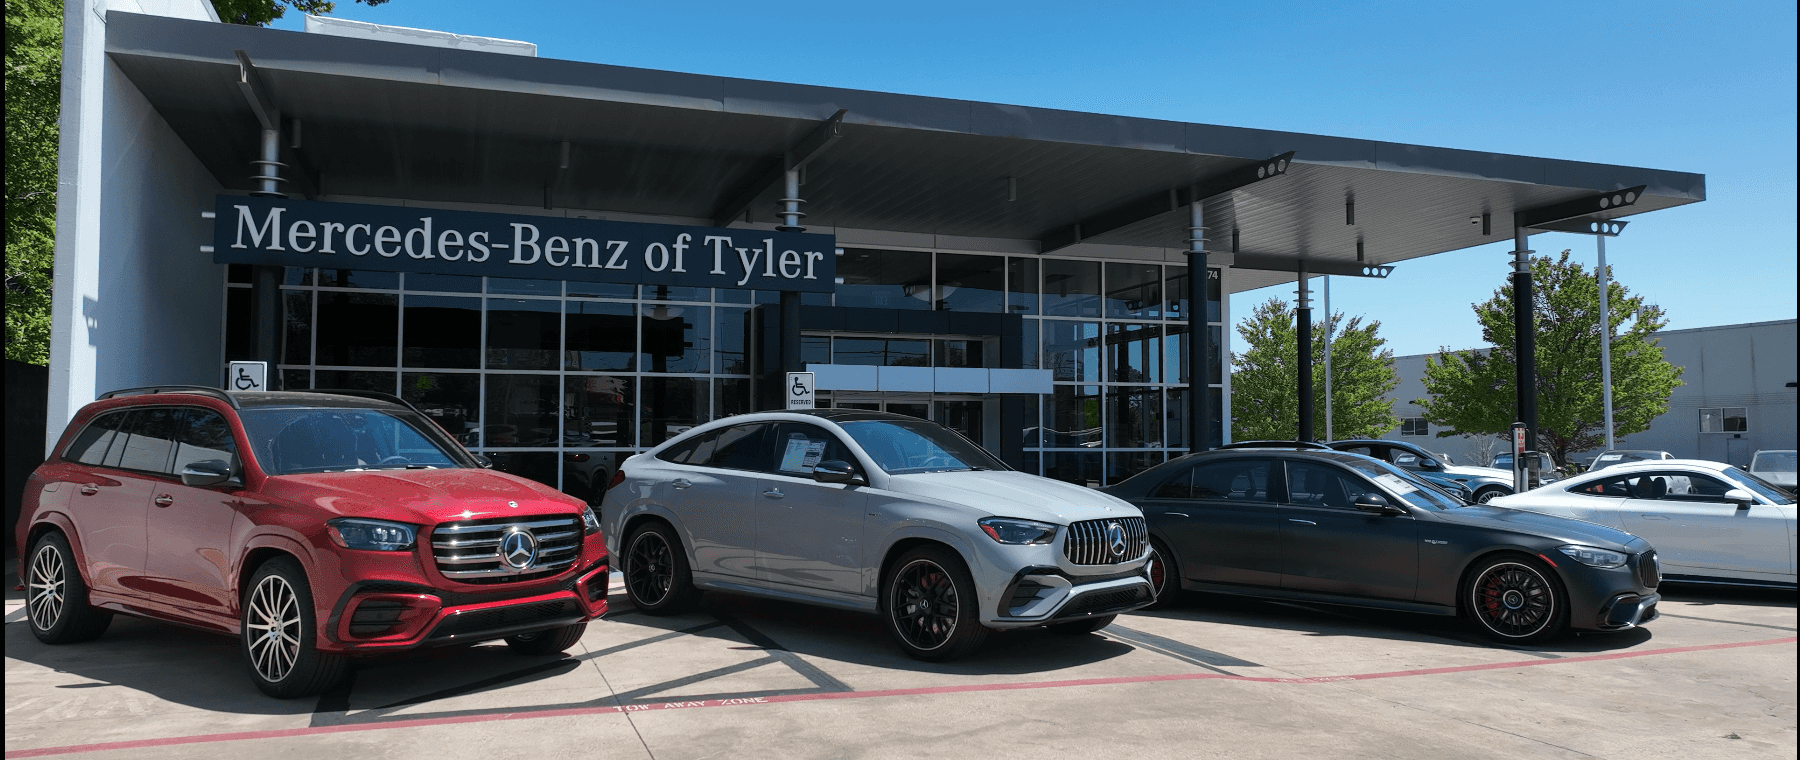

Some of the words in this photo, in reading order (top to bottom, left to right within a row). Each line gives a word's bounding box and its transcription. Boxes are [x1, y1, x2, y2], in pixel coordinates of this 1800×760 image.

[231, 205, 629, 270] Mercedes-Benz
[645, 233, 691, 273] of
[702, 235, 824, 286] Tyler
[1207, 270, 1219, 280] 74
[612, 704, 650, 712] TOW
[664, 701, 706, 709] AWAY
[717, 696, 769, 705] ZONE
